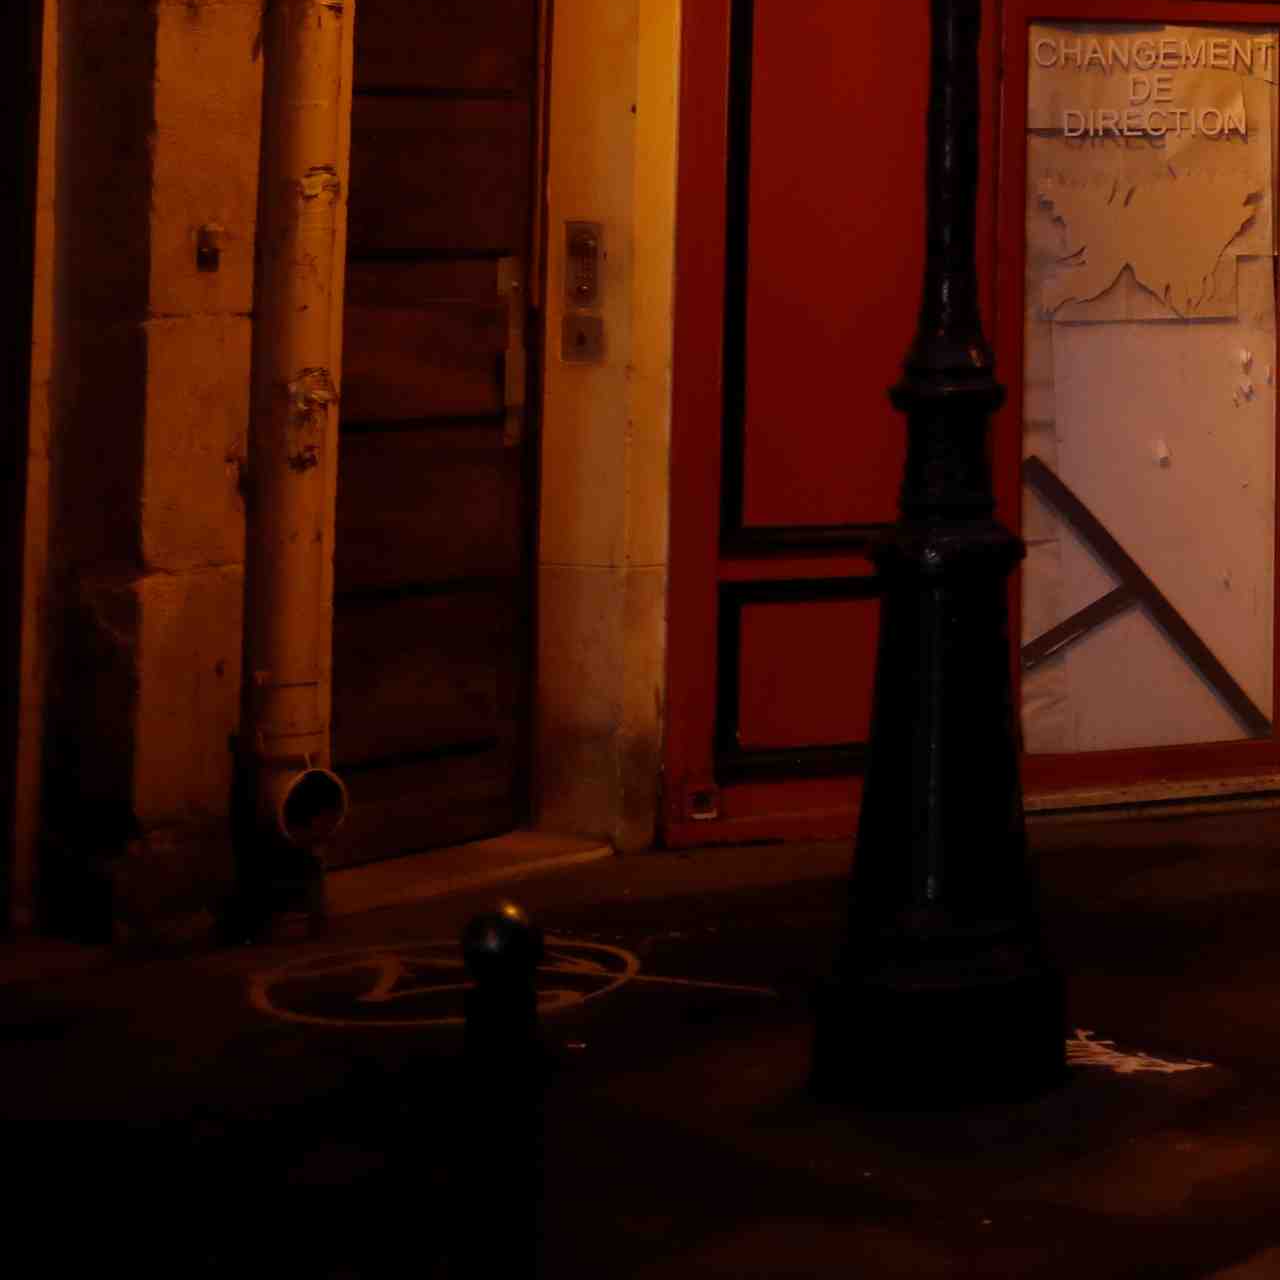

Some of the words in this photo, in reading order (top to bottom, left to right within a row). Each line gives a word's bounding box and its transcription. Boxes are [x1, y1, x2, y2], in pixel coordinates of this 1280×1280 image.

[1034, 39, 1275, 70] CHANGEMENT
[1129, 74, 1174, 104] DE
[1063, 108, 1248, 138] DIRECTION
